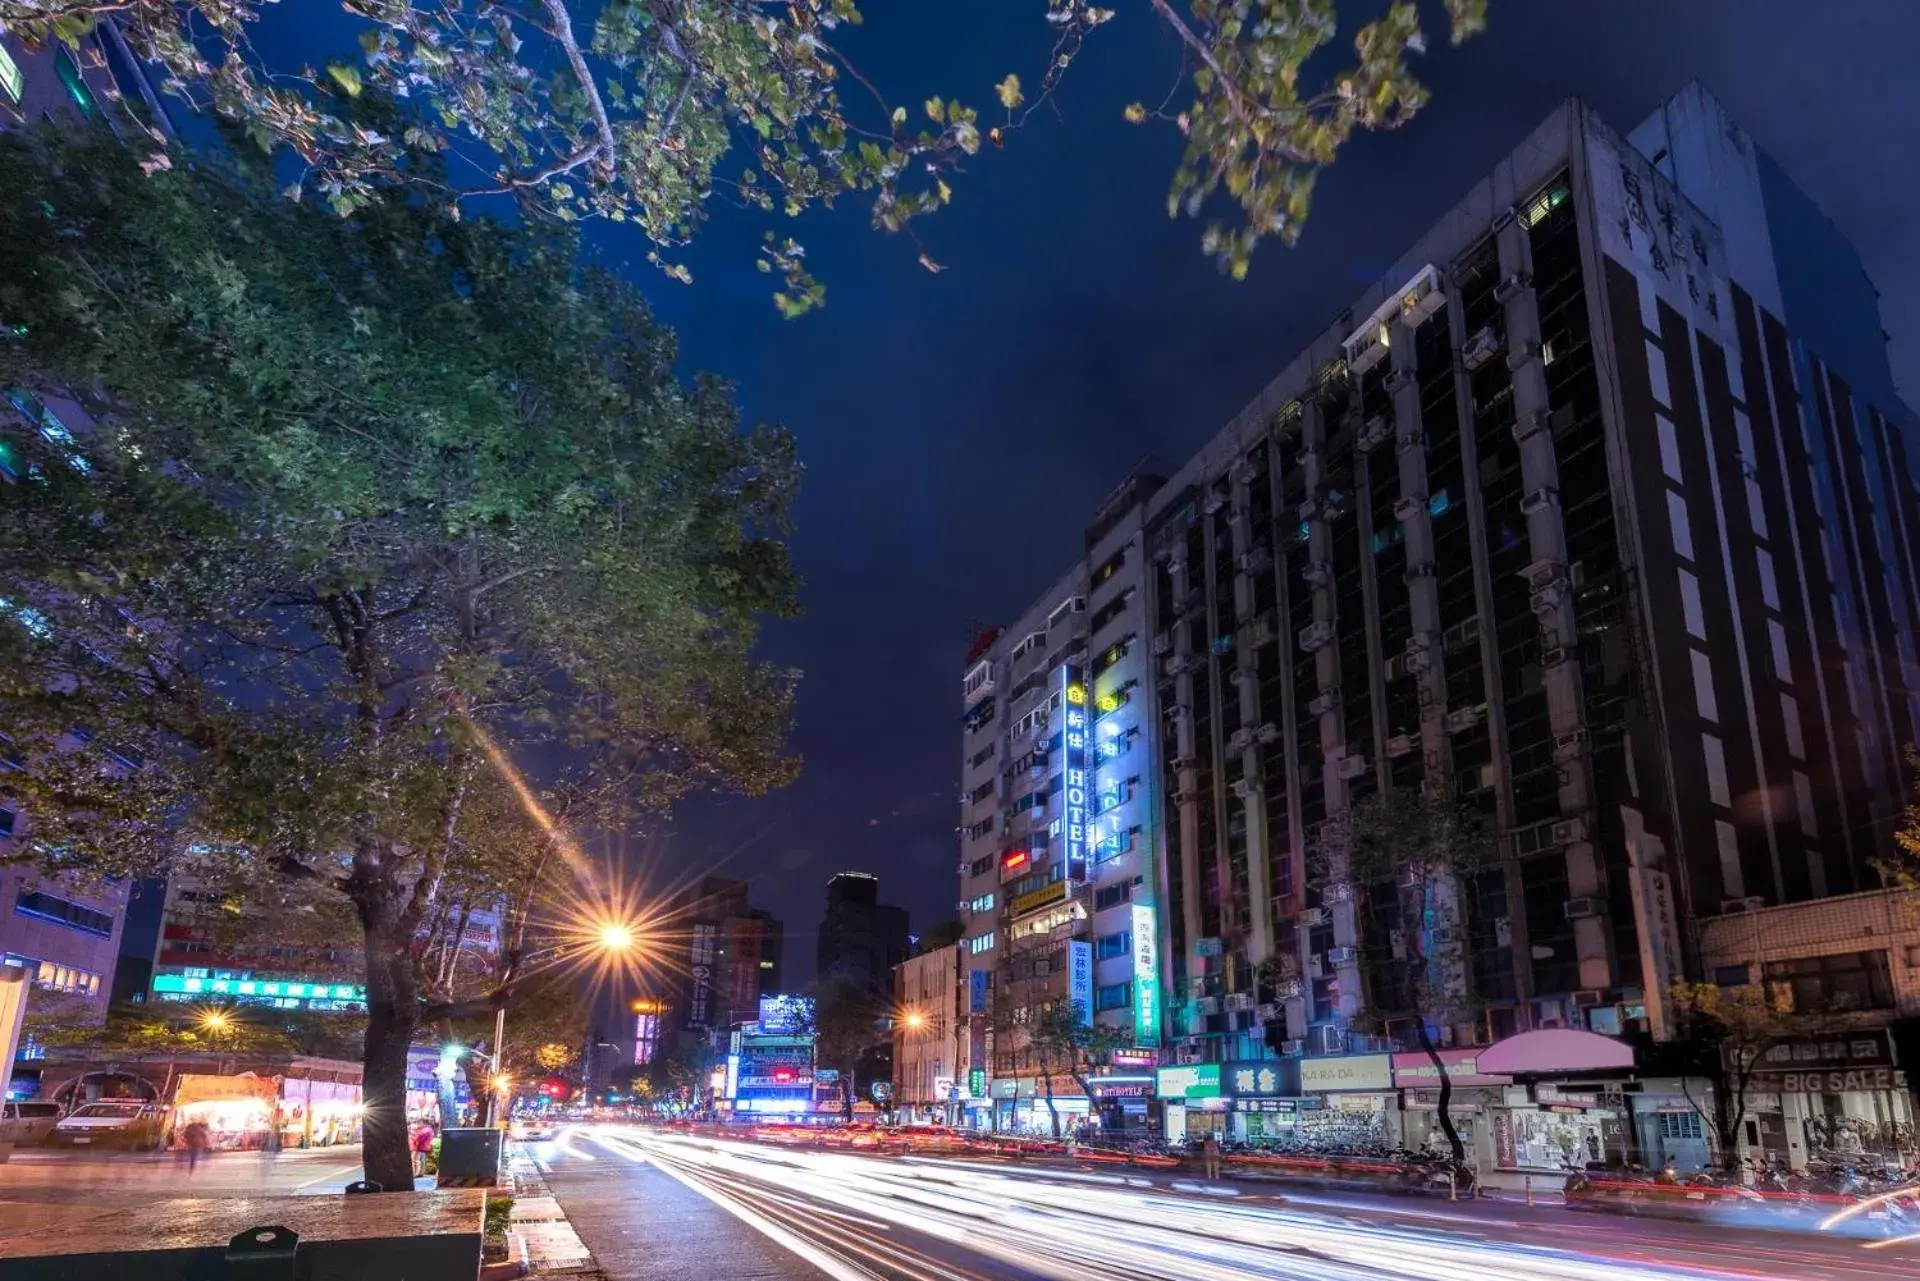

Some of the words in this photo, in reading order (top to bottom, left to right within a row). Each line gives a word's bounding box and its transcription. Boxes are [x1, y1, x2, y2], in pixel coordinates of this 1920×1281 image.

[1069, 770, 1085, 860] HOTEL
[1783, 1073, 1823, 1091] BIG
[1828, 1069, 1890, 1092] SALE
